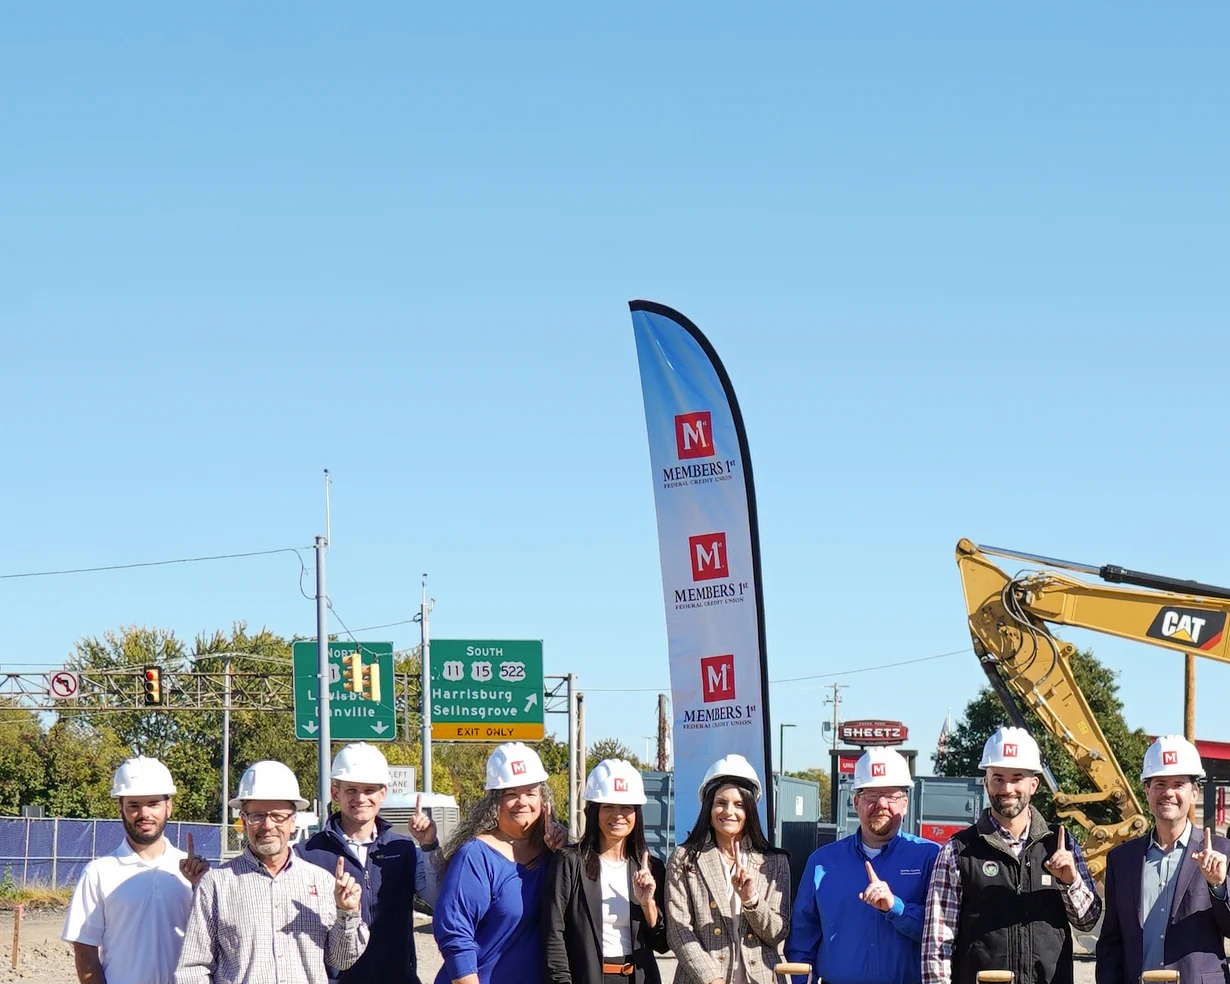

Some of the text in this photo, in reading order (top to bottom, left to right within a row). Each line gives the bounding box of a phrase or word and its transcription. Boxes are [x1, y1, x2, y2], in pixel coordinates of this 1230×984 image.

[663, 460, 736, 482] MEMBERS 1st
[664, 481, 689, 489] FEDERAL
[715, 475, 733, 483] UNION
[674, 582, 748, 603] MEMBERS 1st
[1161, 611, 1206, 643] CAT
[328, 647, 361, 658] NORT
[447, 665, 524, 677] 11 15 522
[432, 688, 512, 703] Harrisburg
[433, 704, 518, 719] Selinsgrove
[683, 705, 756, 722] MEMBERS 1st
[457, 728, 514, 736] EXIT ONLY
[843, 728, 901, 737] SHEETZ
[1006, 745, 1017, 755] M
[1165, 752, 1176, 763] M
[515, 763, 526, 773] M
[873, 764, 885, 775] M
[616, 780, 627, 790] M
